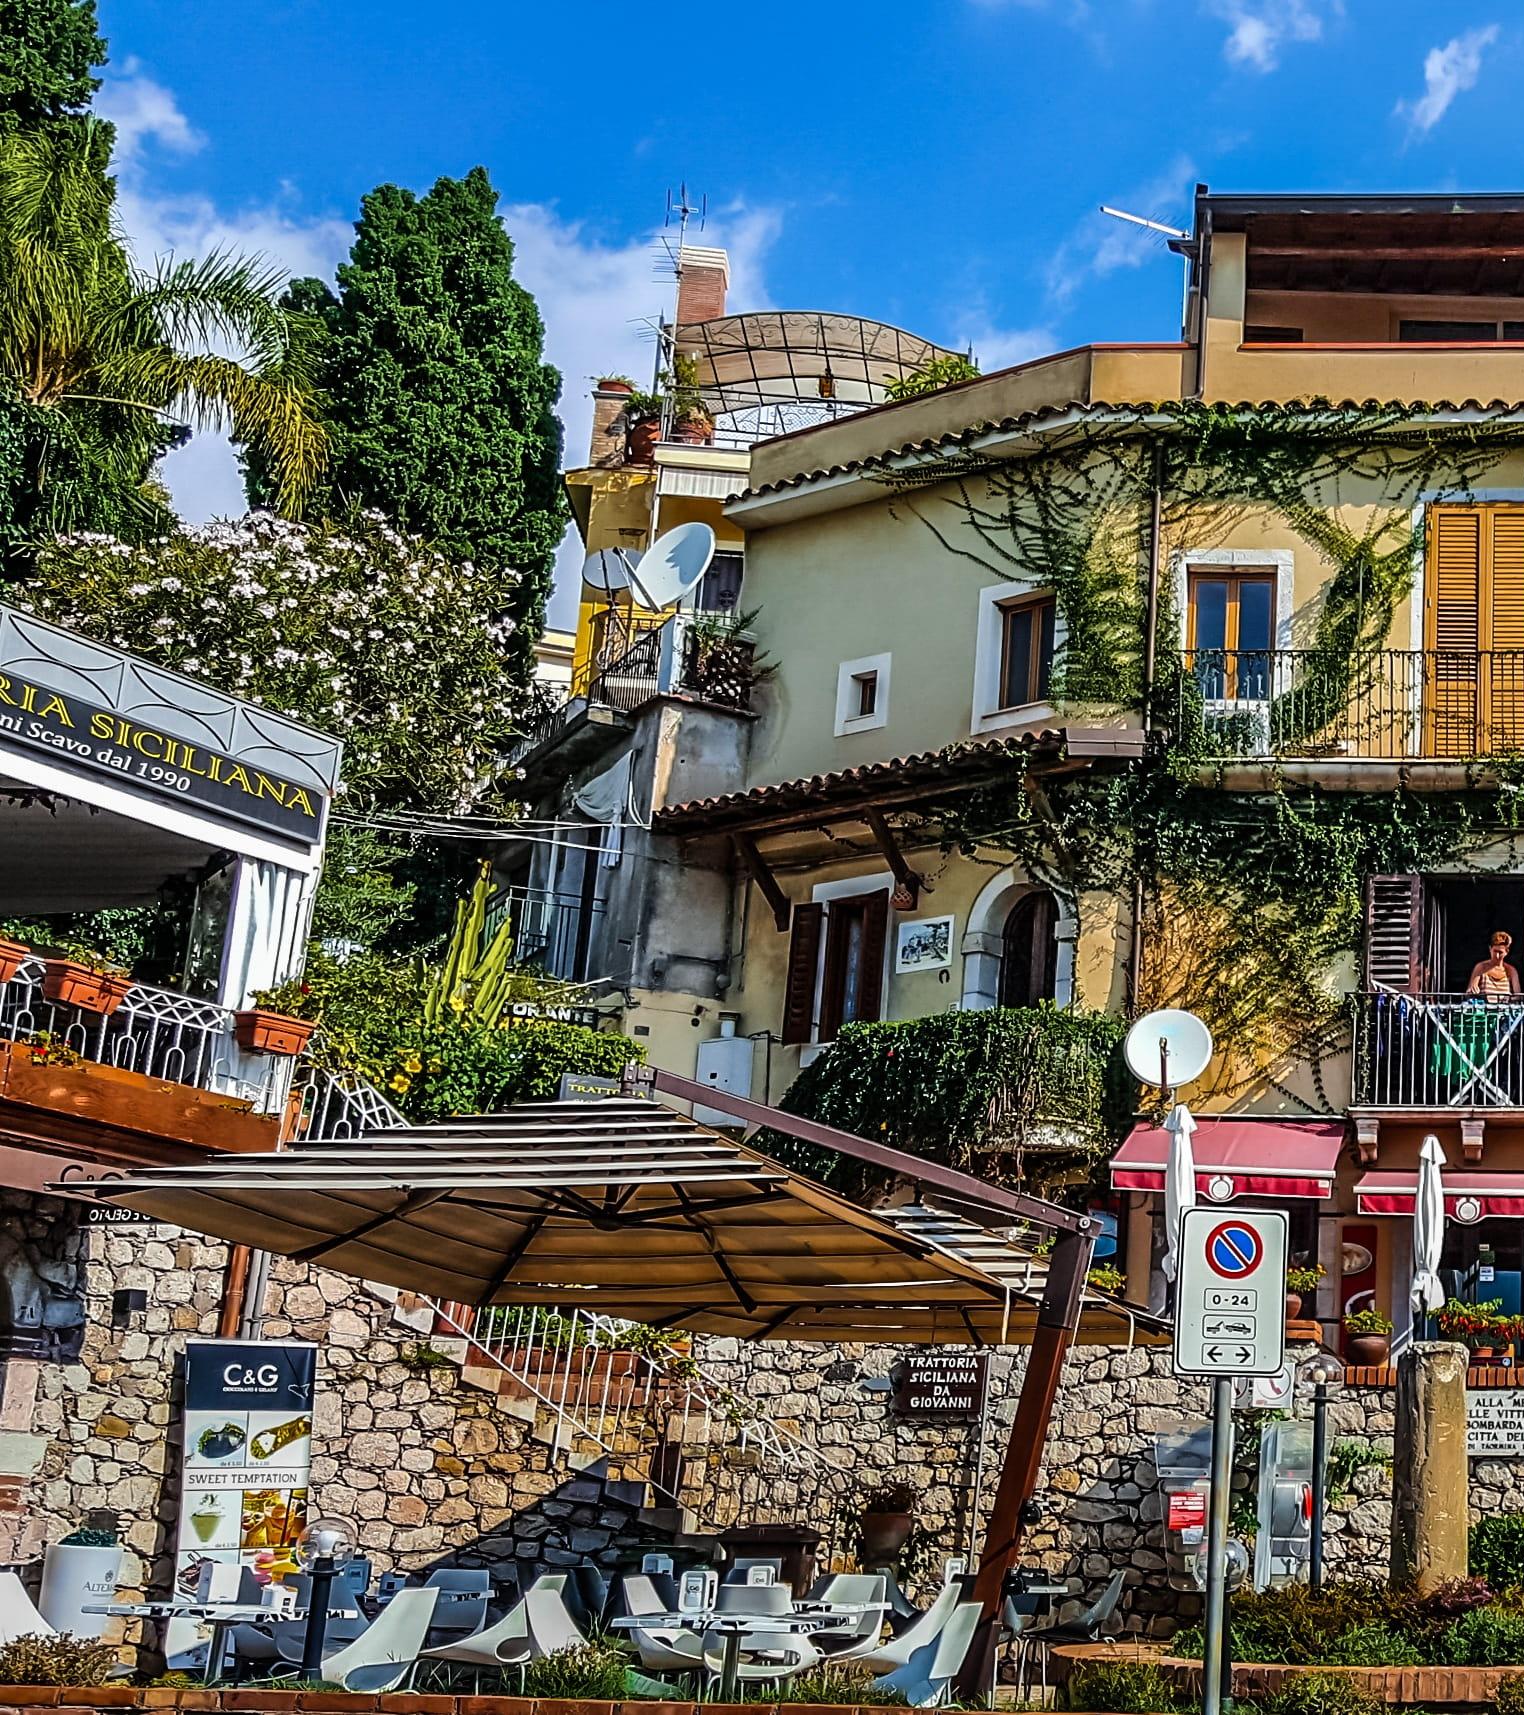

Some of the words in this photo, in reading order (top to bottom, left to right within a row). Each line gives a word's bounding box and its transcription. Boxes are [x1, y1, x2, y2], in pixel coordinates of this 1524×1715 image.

[26, 721, 92, 757] Scavo
[96, 745, 131, 771] dal
[136, 762, 191, 793] 1990
[90, 713, 316, 818] SICILIANA
[568, 1083, 646, 1098] TRATTOIA
[908, 1357, 978, 1369] TRATTORIA
[223, 1363, 279, 1387] C&G
[909, 1371, 977, 1383] SICILIANA
[933, 1385, 951, 1397] DA
[910, 1396, 972, 1408] GIOVANNI
[1475, 1398, 1503, 1408] ALLA
[1467, 1409, 1490, 1419] LLE
[188, 1474, 228, 1485] SWEET
[231, 1473, 298, 1484] TEMPTATION
